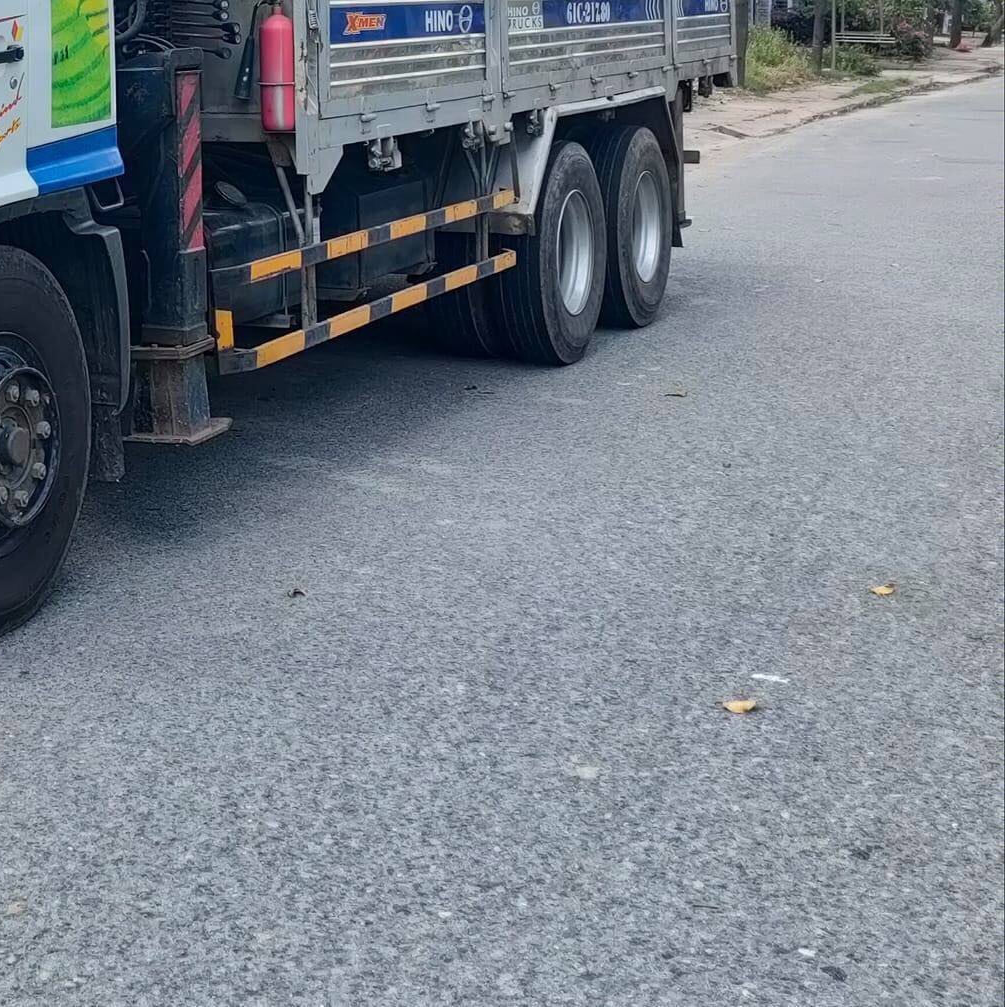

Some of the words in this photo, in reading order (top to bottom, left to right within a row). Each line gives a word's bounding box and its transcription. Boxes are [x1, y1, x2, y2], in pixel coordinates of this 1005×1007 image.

[425, 10, 454, 33] HINO
[507, 6, 529, 17] HINO
[342, 12, 387, 35] X-MEN
